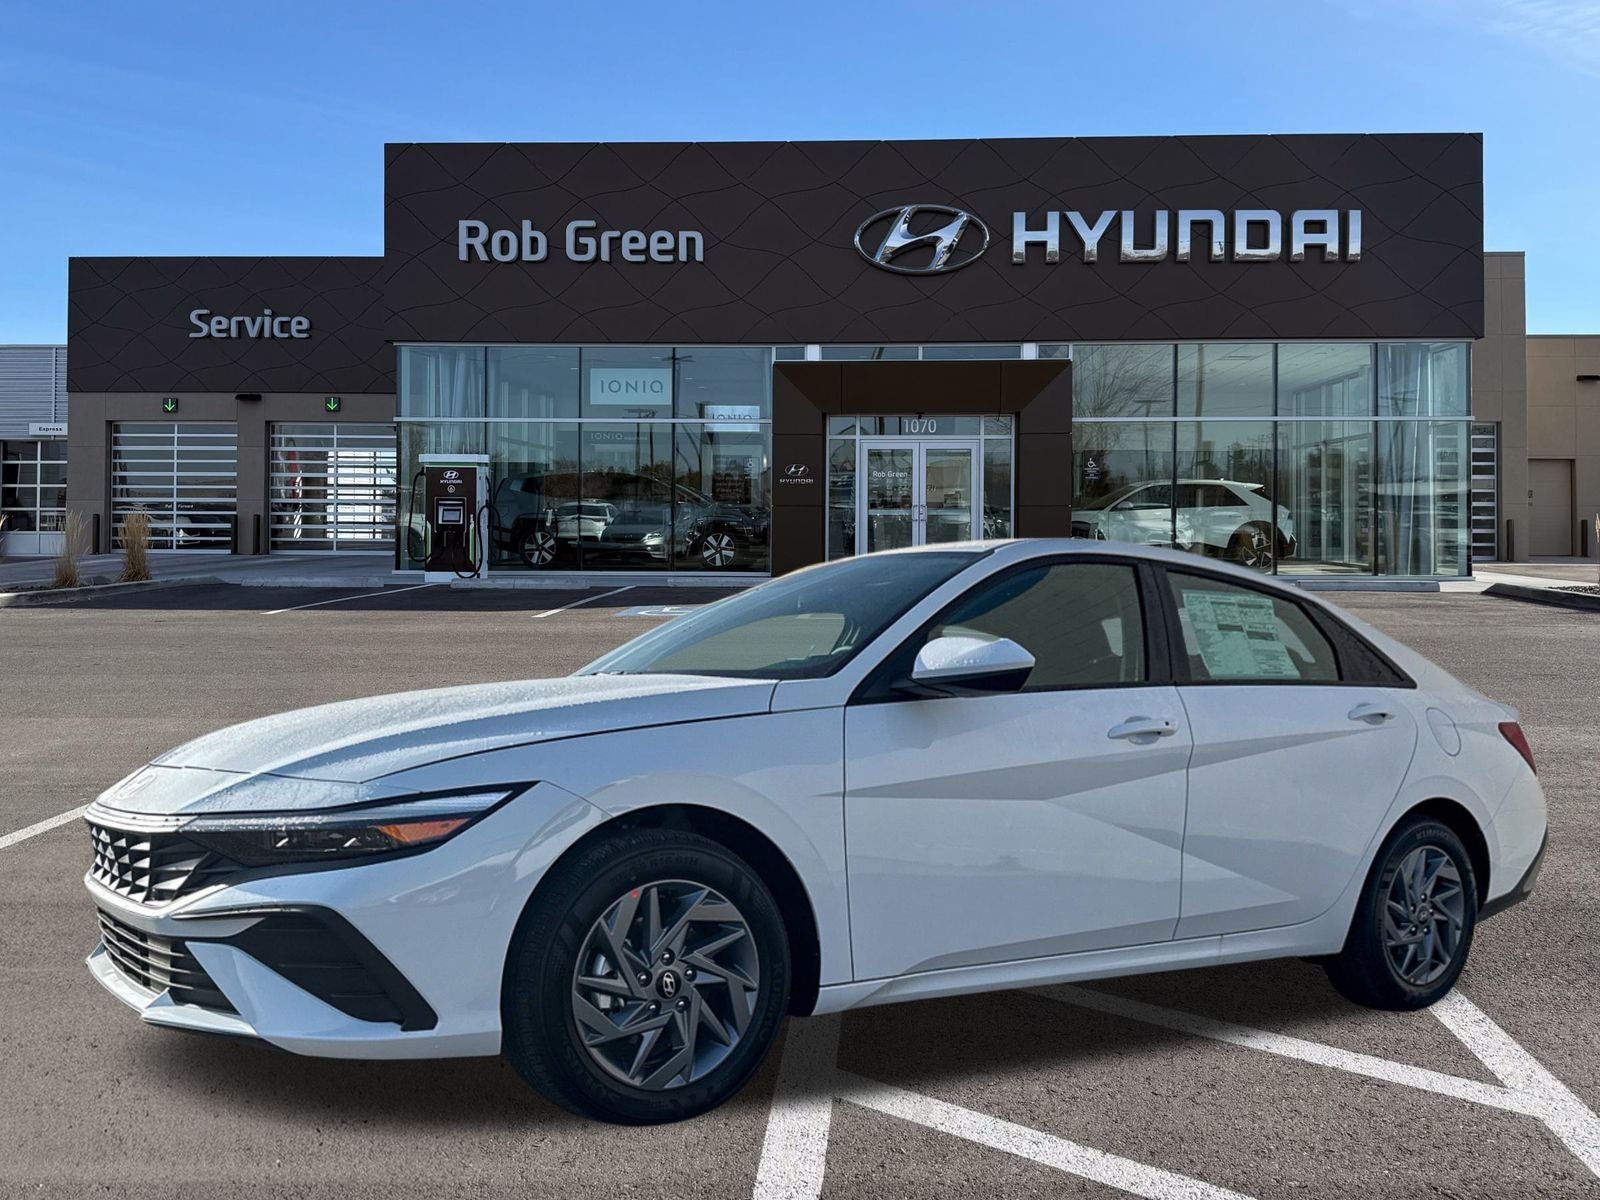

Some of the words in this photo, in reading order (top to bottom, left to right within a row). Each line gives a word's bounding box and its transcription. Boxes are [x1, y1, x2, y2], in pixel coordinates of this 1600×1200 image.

[458, 219, 548, 262] Rob
[565, 219, 704, 262] Green
[1011, 209, 1362, 264] HYUNDAI
[189, 309, 311, 338] Service
[601, 380, 664, 393] IONIQ
[904, 419, 937, 433] 1070
[591, 432, 624, 440] IONIQ
[872, 470, 886, 478] Rob
[887, 470, 908, 478] Green
